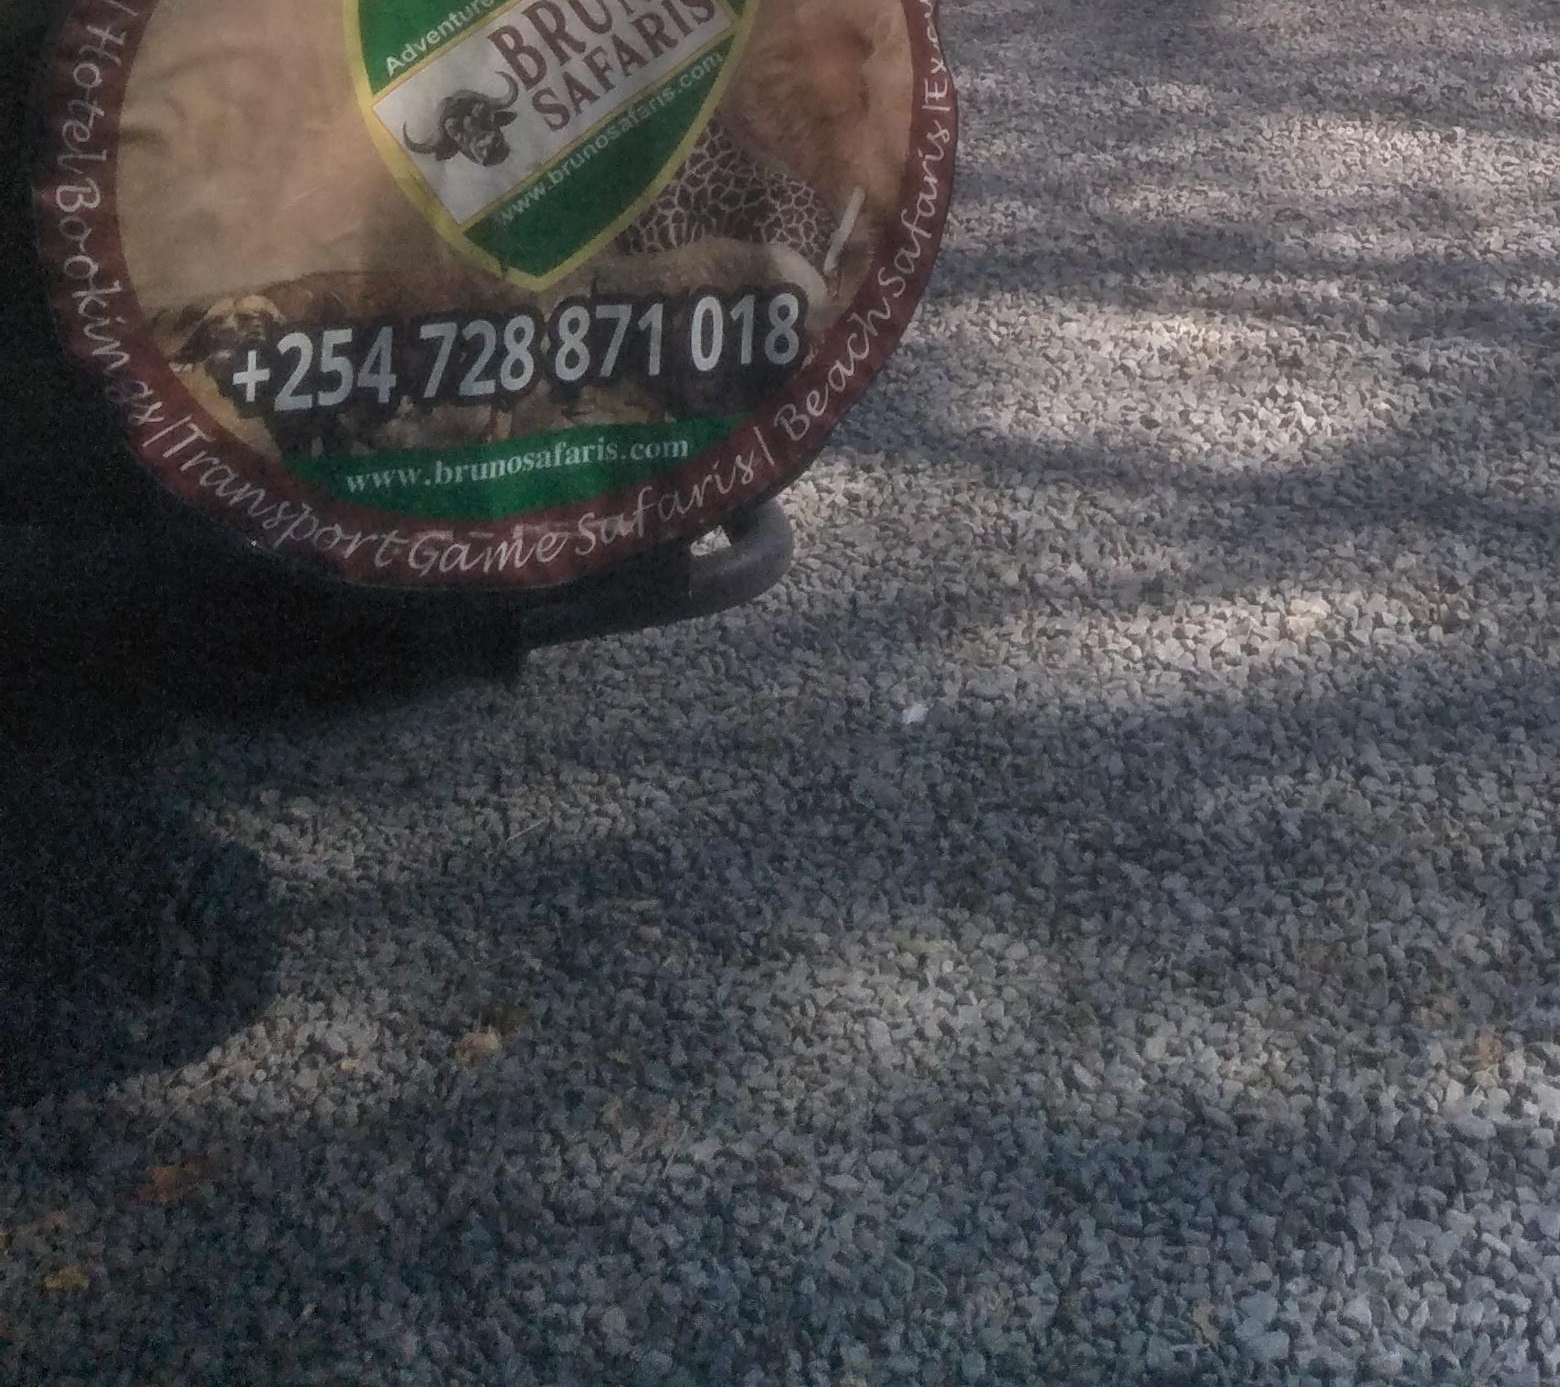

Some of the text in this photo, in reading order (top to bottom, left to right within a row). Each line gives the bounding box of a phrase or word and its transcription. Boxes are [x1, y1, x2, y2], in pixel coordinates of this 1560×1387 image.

[57, 22, 126, 176] Hotel
[878, 120, 951, 298] Safaris
[56, 177, 165, 426] Bookings
[232, 292, 800, 412] +254 728 871 018
[774, 297, 891, 442] Beach
[163, 426, 409, 569] Transport
[346, 435, 689, 493] www.brunosafaris.com
[575, 451, 755, 556] Safaris
[408, 528, 568, 577] Game
